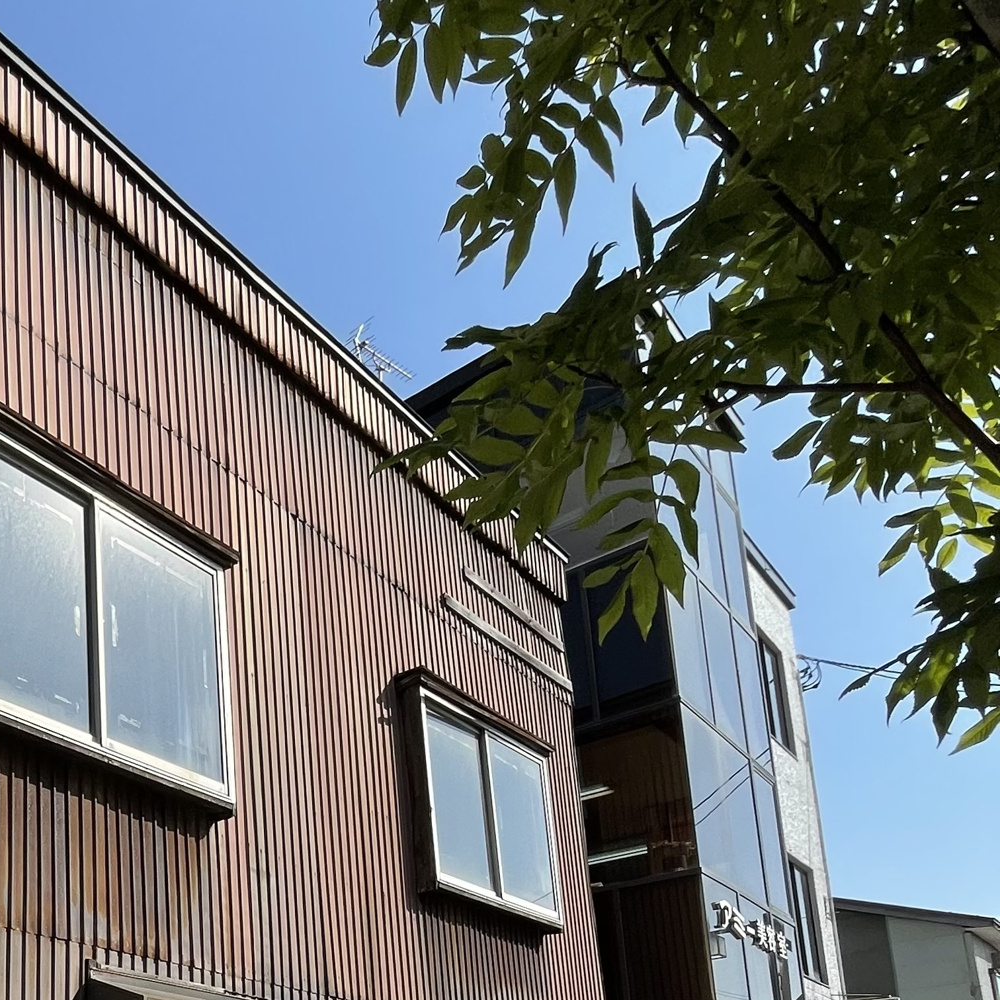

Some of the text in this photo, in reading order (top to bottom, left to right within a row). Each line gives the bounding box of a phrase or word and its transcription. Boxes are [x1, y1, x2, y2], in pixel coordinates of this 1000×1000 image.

[711, 899, 789, 960] アミー美容室
